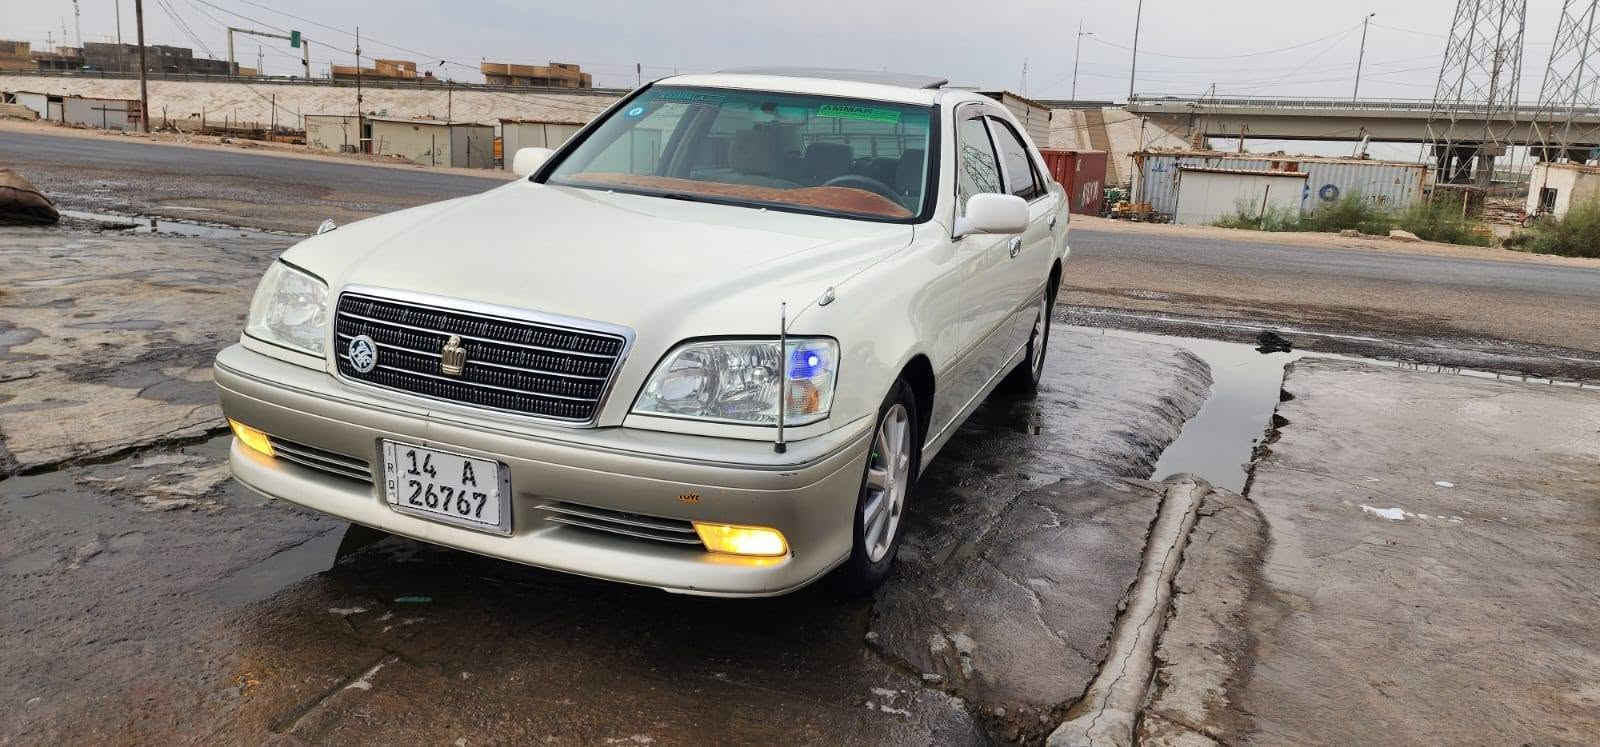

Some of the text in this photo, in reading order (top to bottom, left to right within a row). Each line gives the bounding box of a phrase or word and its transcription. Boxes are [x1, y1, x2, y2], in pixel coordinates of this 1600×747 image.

[406, 449, 477, 487] 14 A
[408, 479, 487, 518] 26767
